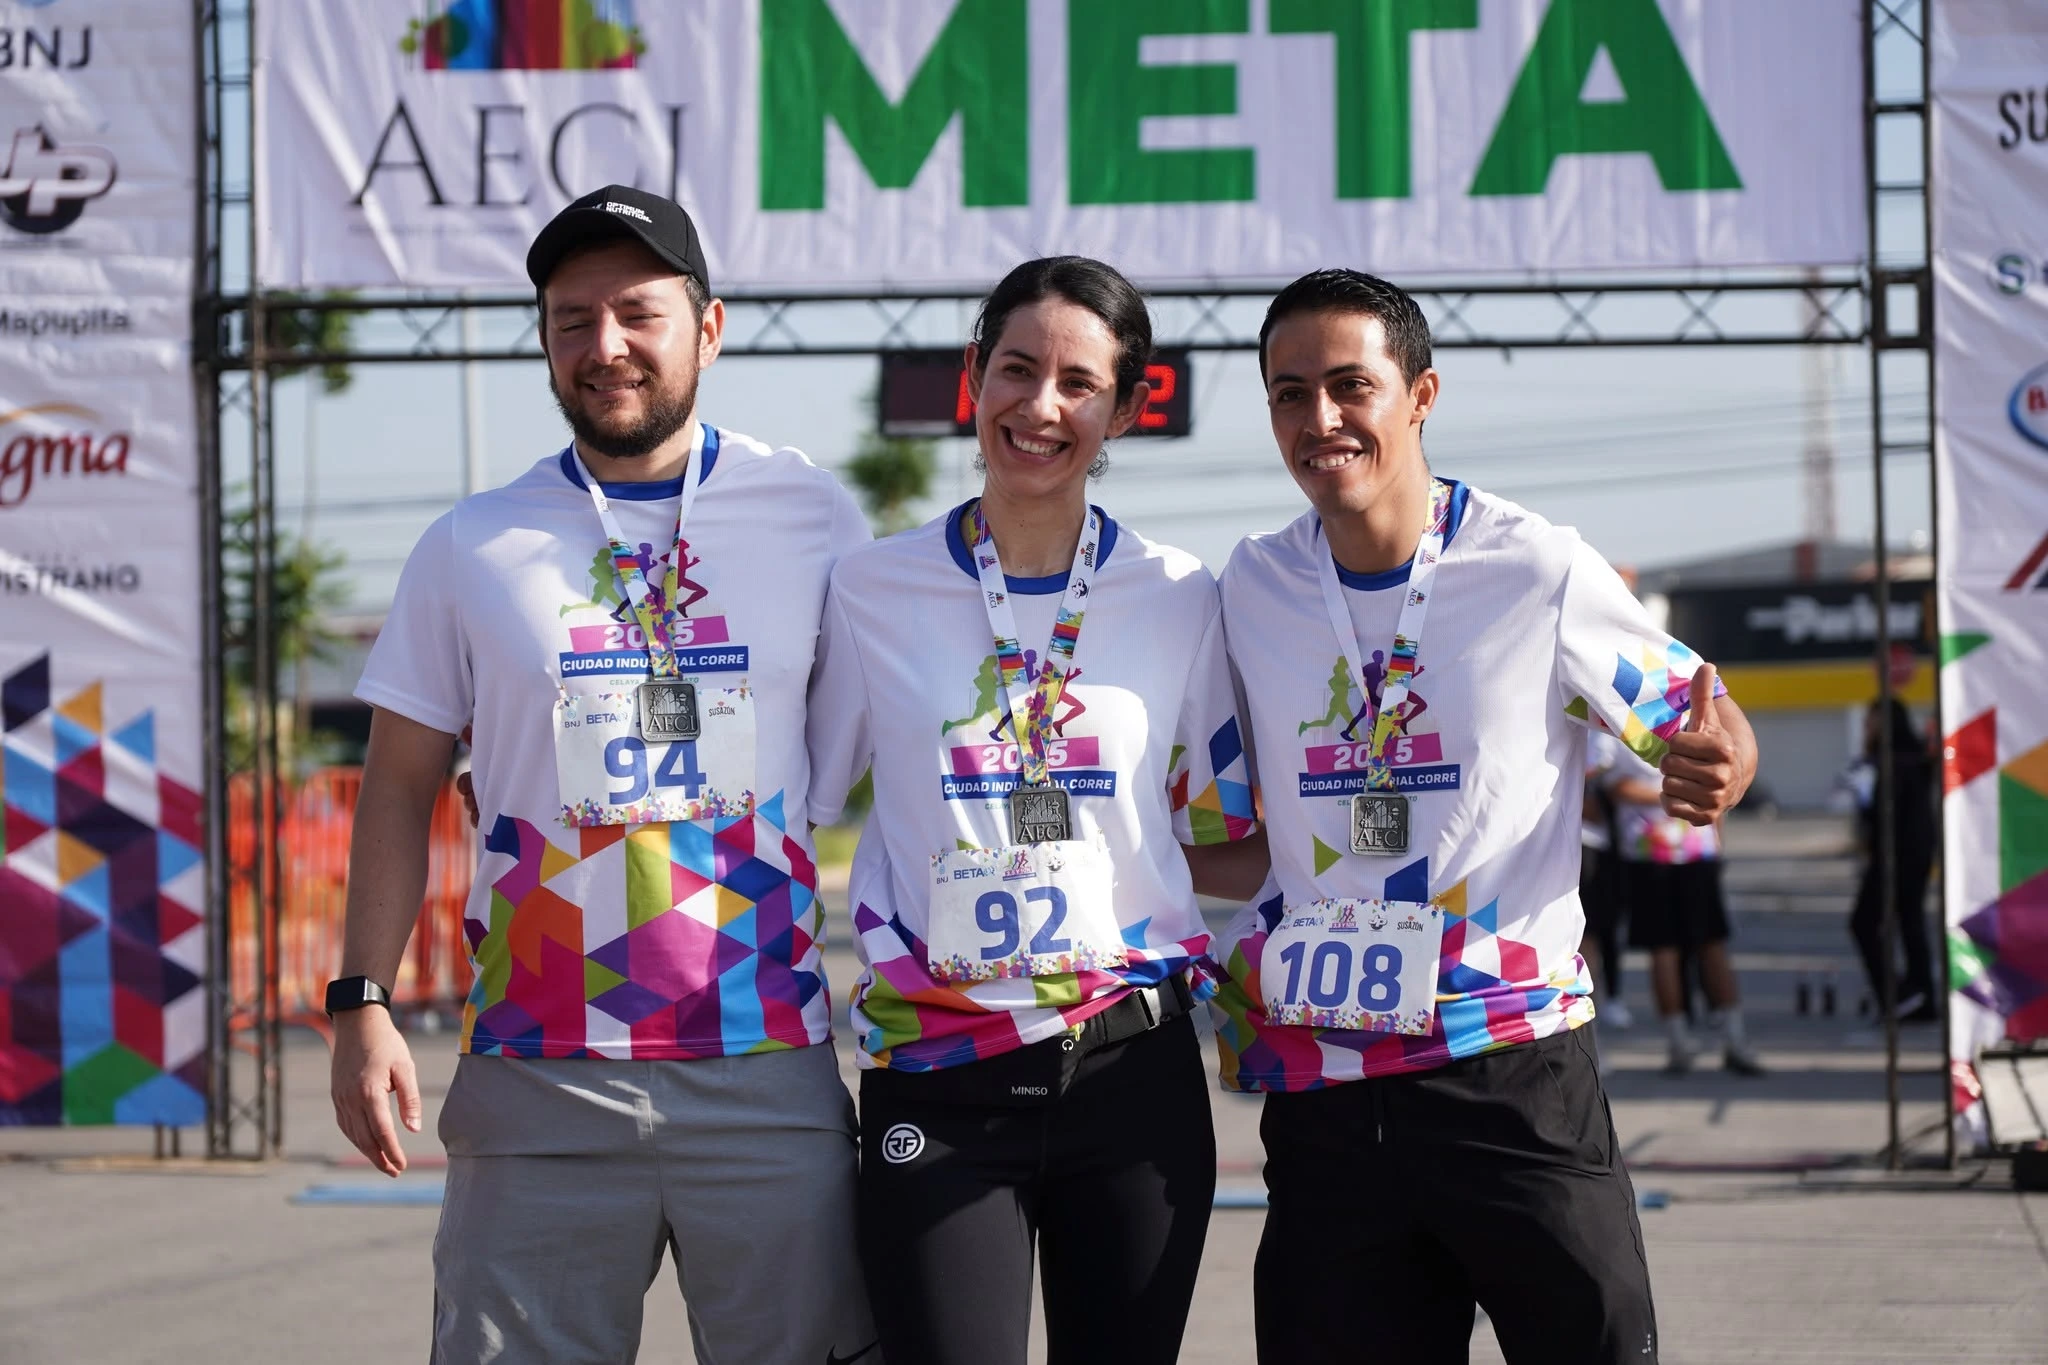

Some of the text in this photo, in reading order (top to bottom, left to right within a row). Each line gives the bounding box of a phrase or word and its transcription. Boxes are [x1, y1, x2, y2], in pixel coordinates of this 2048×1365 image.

[760, 0, 1743, 209] META
[352, 97, 687, 206] AECI
[606, 201, 646, 215] OPTIMUM
[604, 620, 695, 649] 205
[562, 653, 745, 671] CIUDAD INDUIAL CORRE
[564, 720, 581, 729] BNJ
[647, 714, 697, 733] AECI
[981, 740, 1068, 772] 205
[1333, 737, 1413, 771] 205
[603, 736, 707, 805] 94
[943, 779, 990, 794] CIUDAD
[1069, 777, 1113, 791] CORRE
[1300, 779, 1342, 792] CIUDAD
[1416, 772, 1457, 785] CORRE
[1018, 824, 1067, 842] AECI
[1355, 828, 1405, 847] AECI
[936, 876, 949, 885] BNJ
[974, 886, 1072, 961] 92
[1280, 940, 1403, 1013] 108
[1011, 1086, 1048, 1096] MINISO
